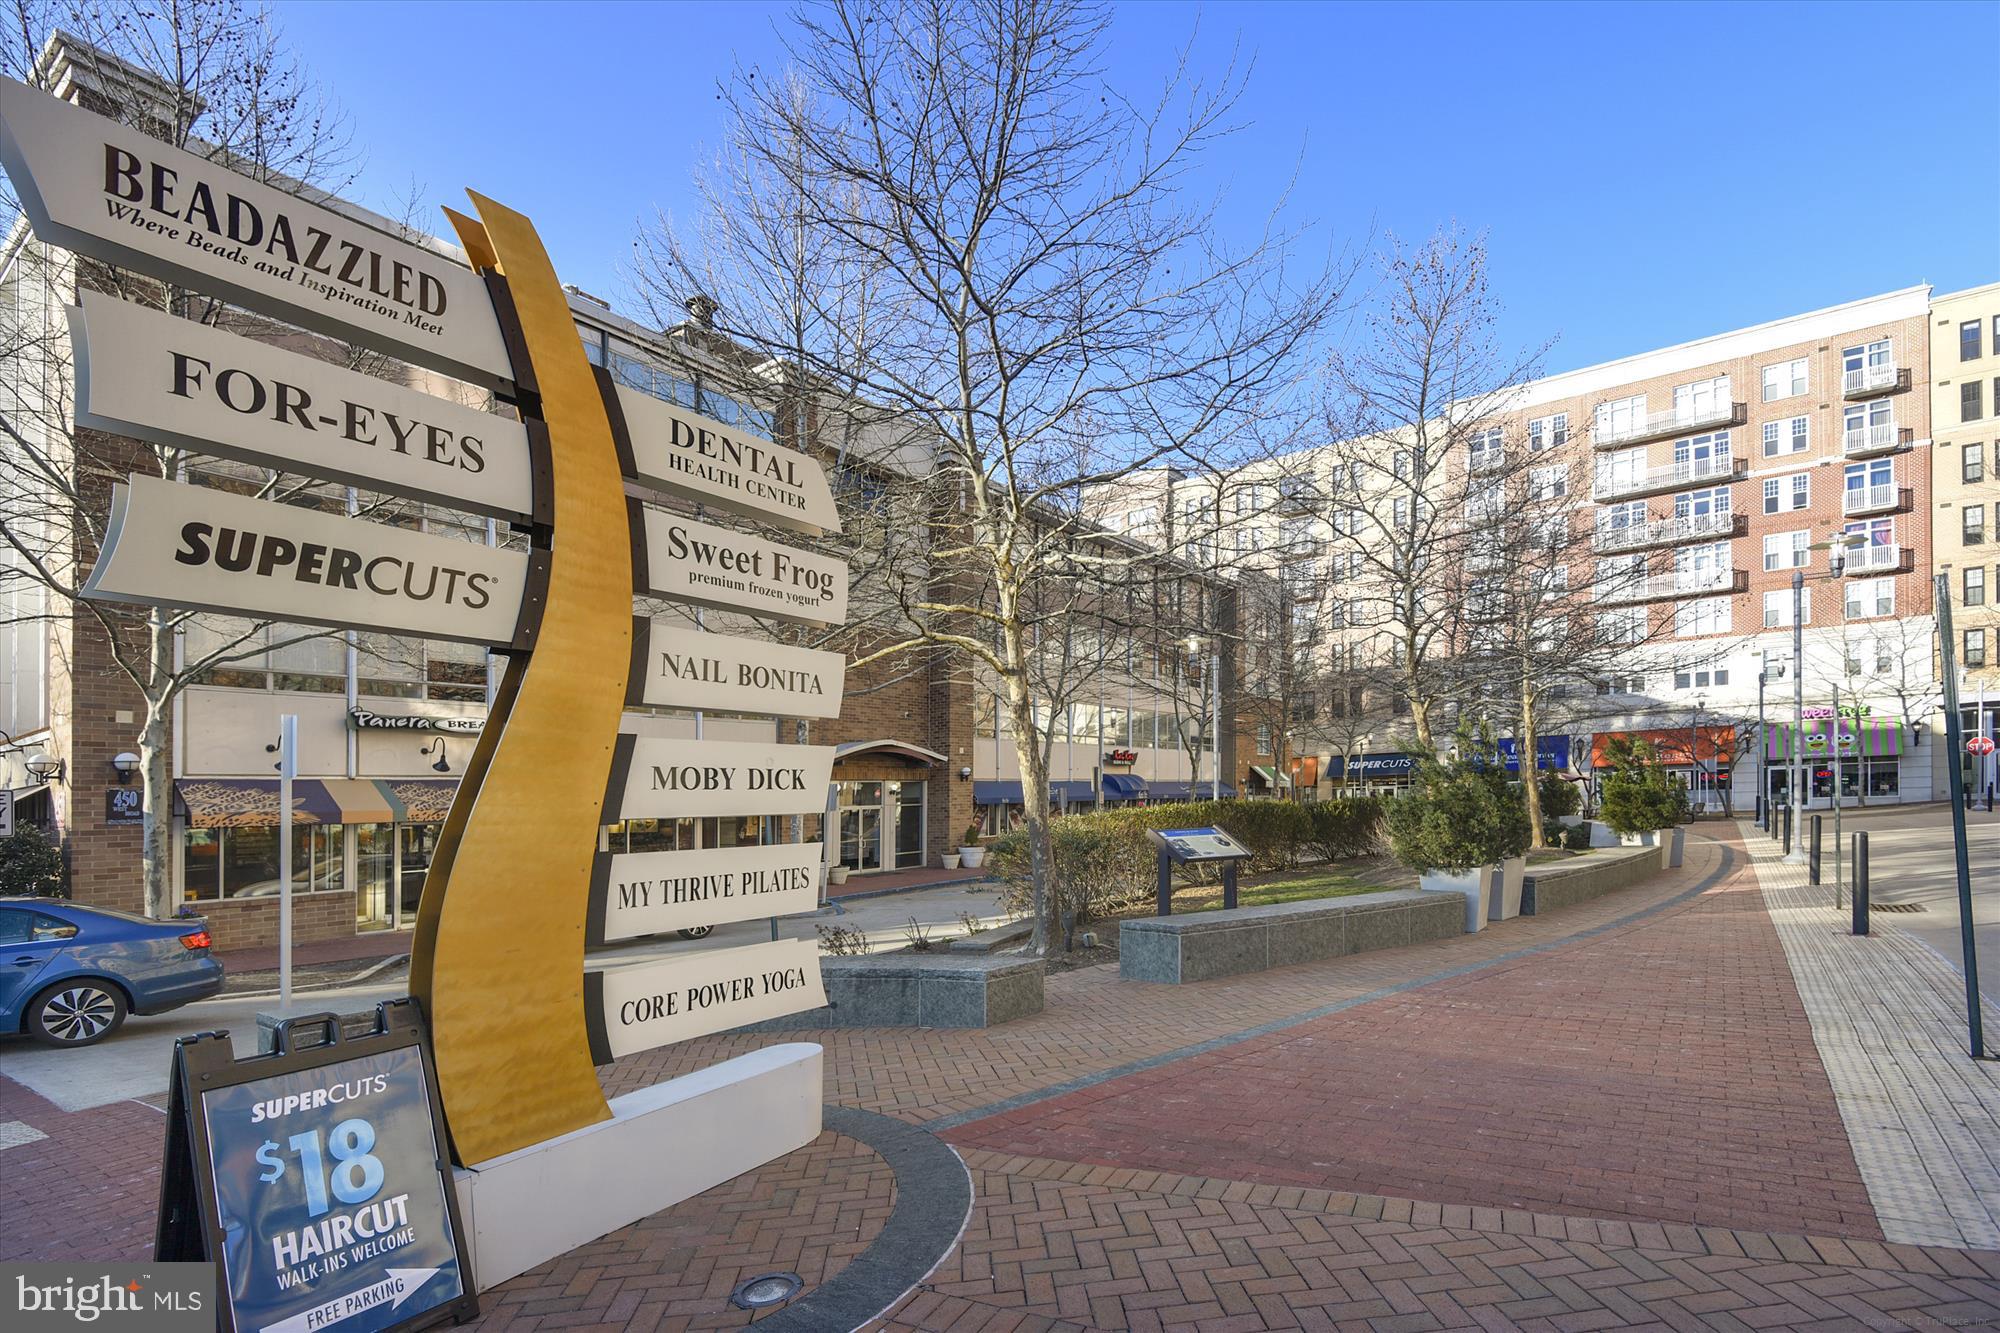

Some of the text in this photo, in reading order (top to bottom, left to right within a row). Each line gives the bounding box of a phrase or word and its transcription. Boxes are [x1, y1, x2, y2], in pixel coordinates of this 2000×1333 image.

[103, 143, 447, 317] BEADAZZLED
[106, 200, 444, 337] Where Beads and Inspiration Meet
[167, 350, 485, 474] FOR-EYES
[668, 416, 804, 489] DENTAL
[669, 453, 806, 510] HEALTH CENTER
[668, 526, 834, 601] Sweet Frog
[689, 569, 820, 608] premium frozen yogurt
[661, 652, 823, 695] NAIL BONITA
[354, 711, 484, 729] Panera BREA
[113, 791, 138, 807] 450
[651, 766, 807, 791] MOBY DICK
[617, 866, 810, 910] MY THRIVE PILATES
[620, 967, 806, 1026] CORE POWER YOGA
[272, 1194, 409, 1270] HAIRCUT
[276, 1227, 416, 1290] WALK-INS WELCOME
[306, 1276, 405, 1329] FREE PARKING
